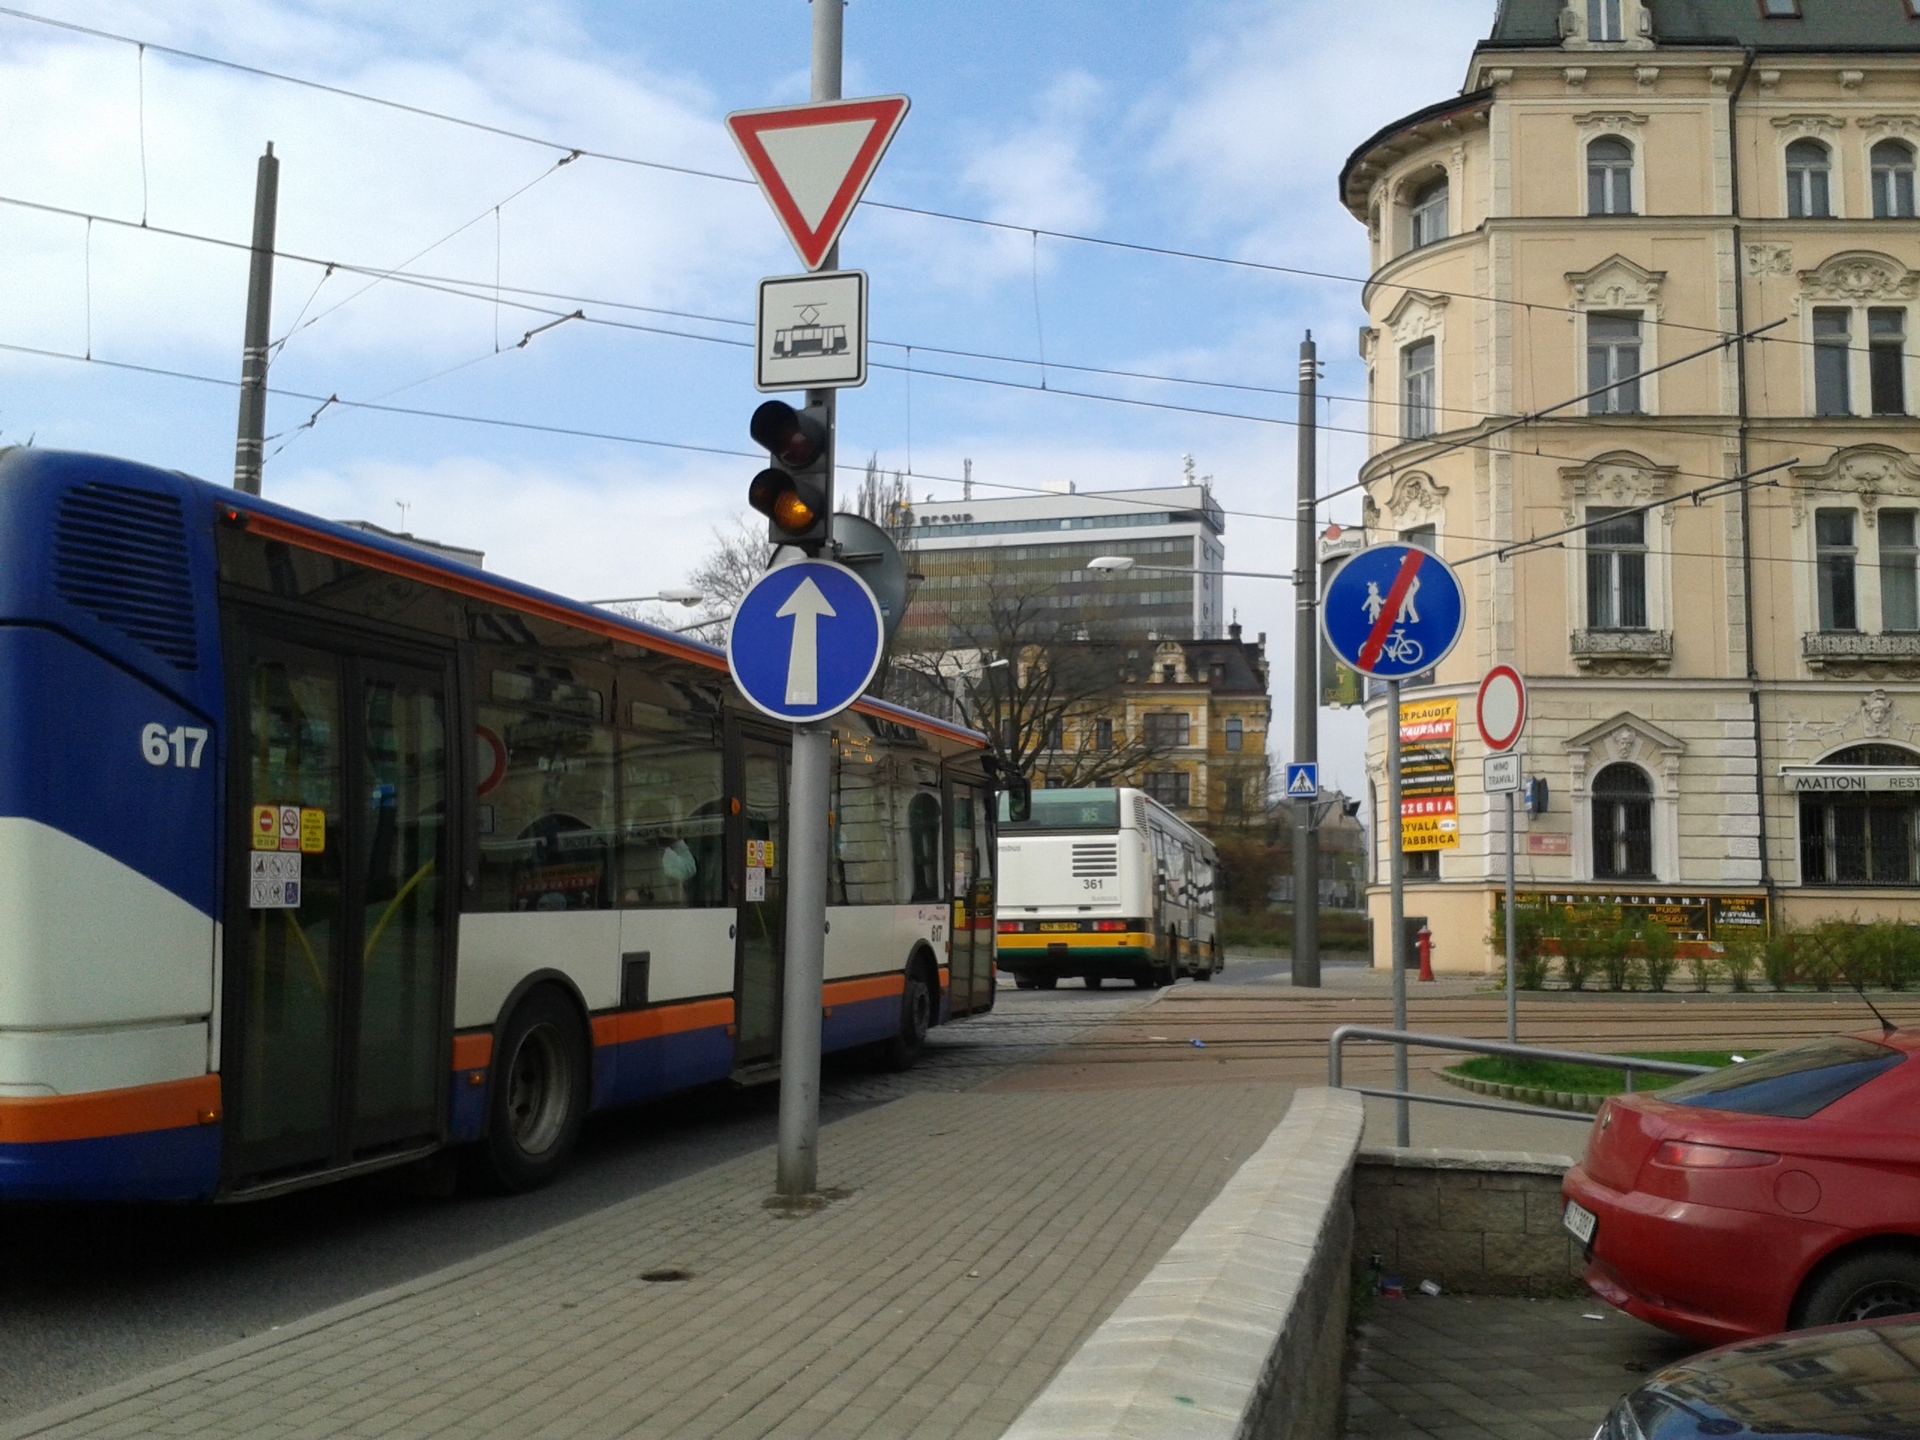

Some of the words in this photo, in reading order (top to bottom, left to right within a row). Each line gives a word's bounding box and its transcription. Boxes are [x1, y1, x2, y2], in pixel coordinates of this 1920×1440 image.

[920, 513, 973, 526] group
[1411, 706, 1451, 719] PLAUDIT
[1400, 722, 1451, 737] TAURANT
[142, 722, 208, 767] 617
[1493, 761, 1509, 771] MIMO
[1488, 773, 1514, 786] TRAMVAJ
[1795, 776, 1866, 790] MATTONI
[1401, 800, 1453, 814] ZZERIA
[1403, 834, 1455, 846] FABBRICA
[1082, 879, 1103, 889] 361
